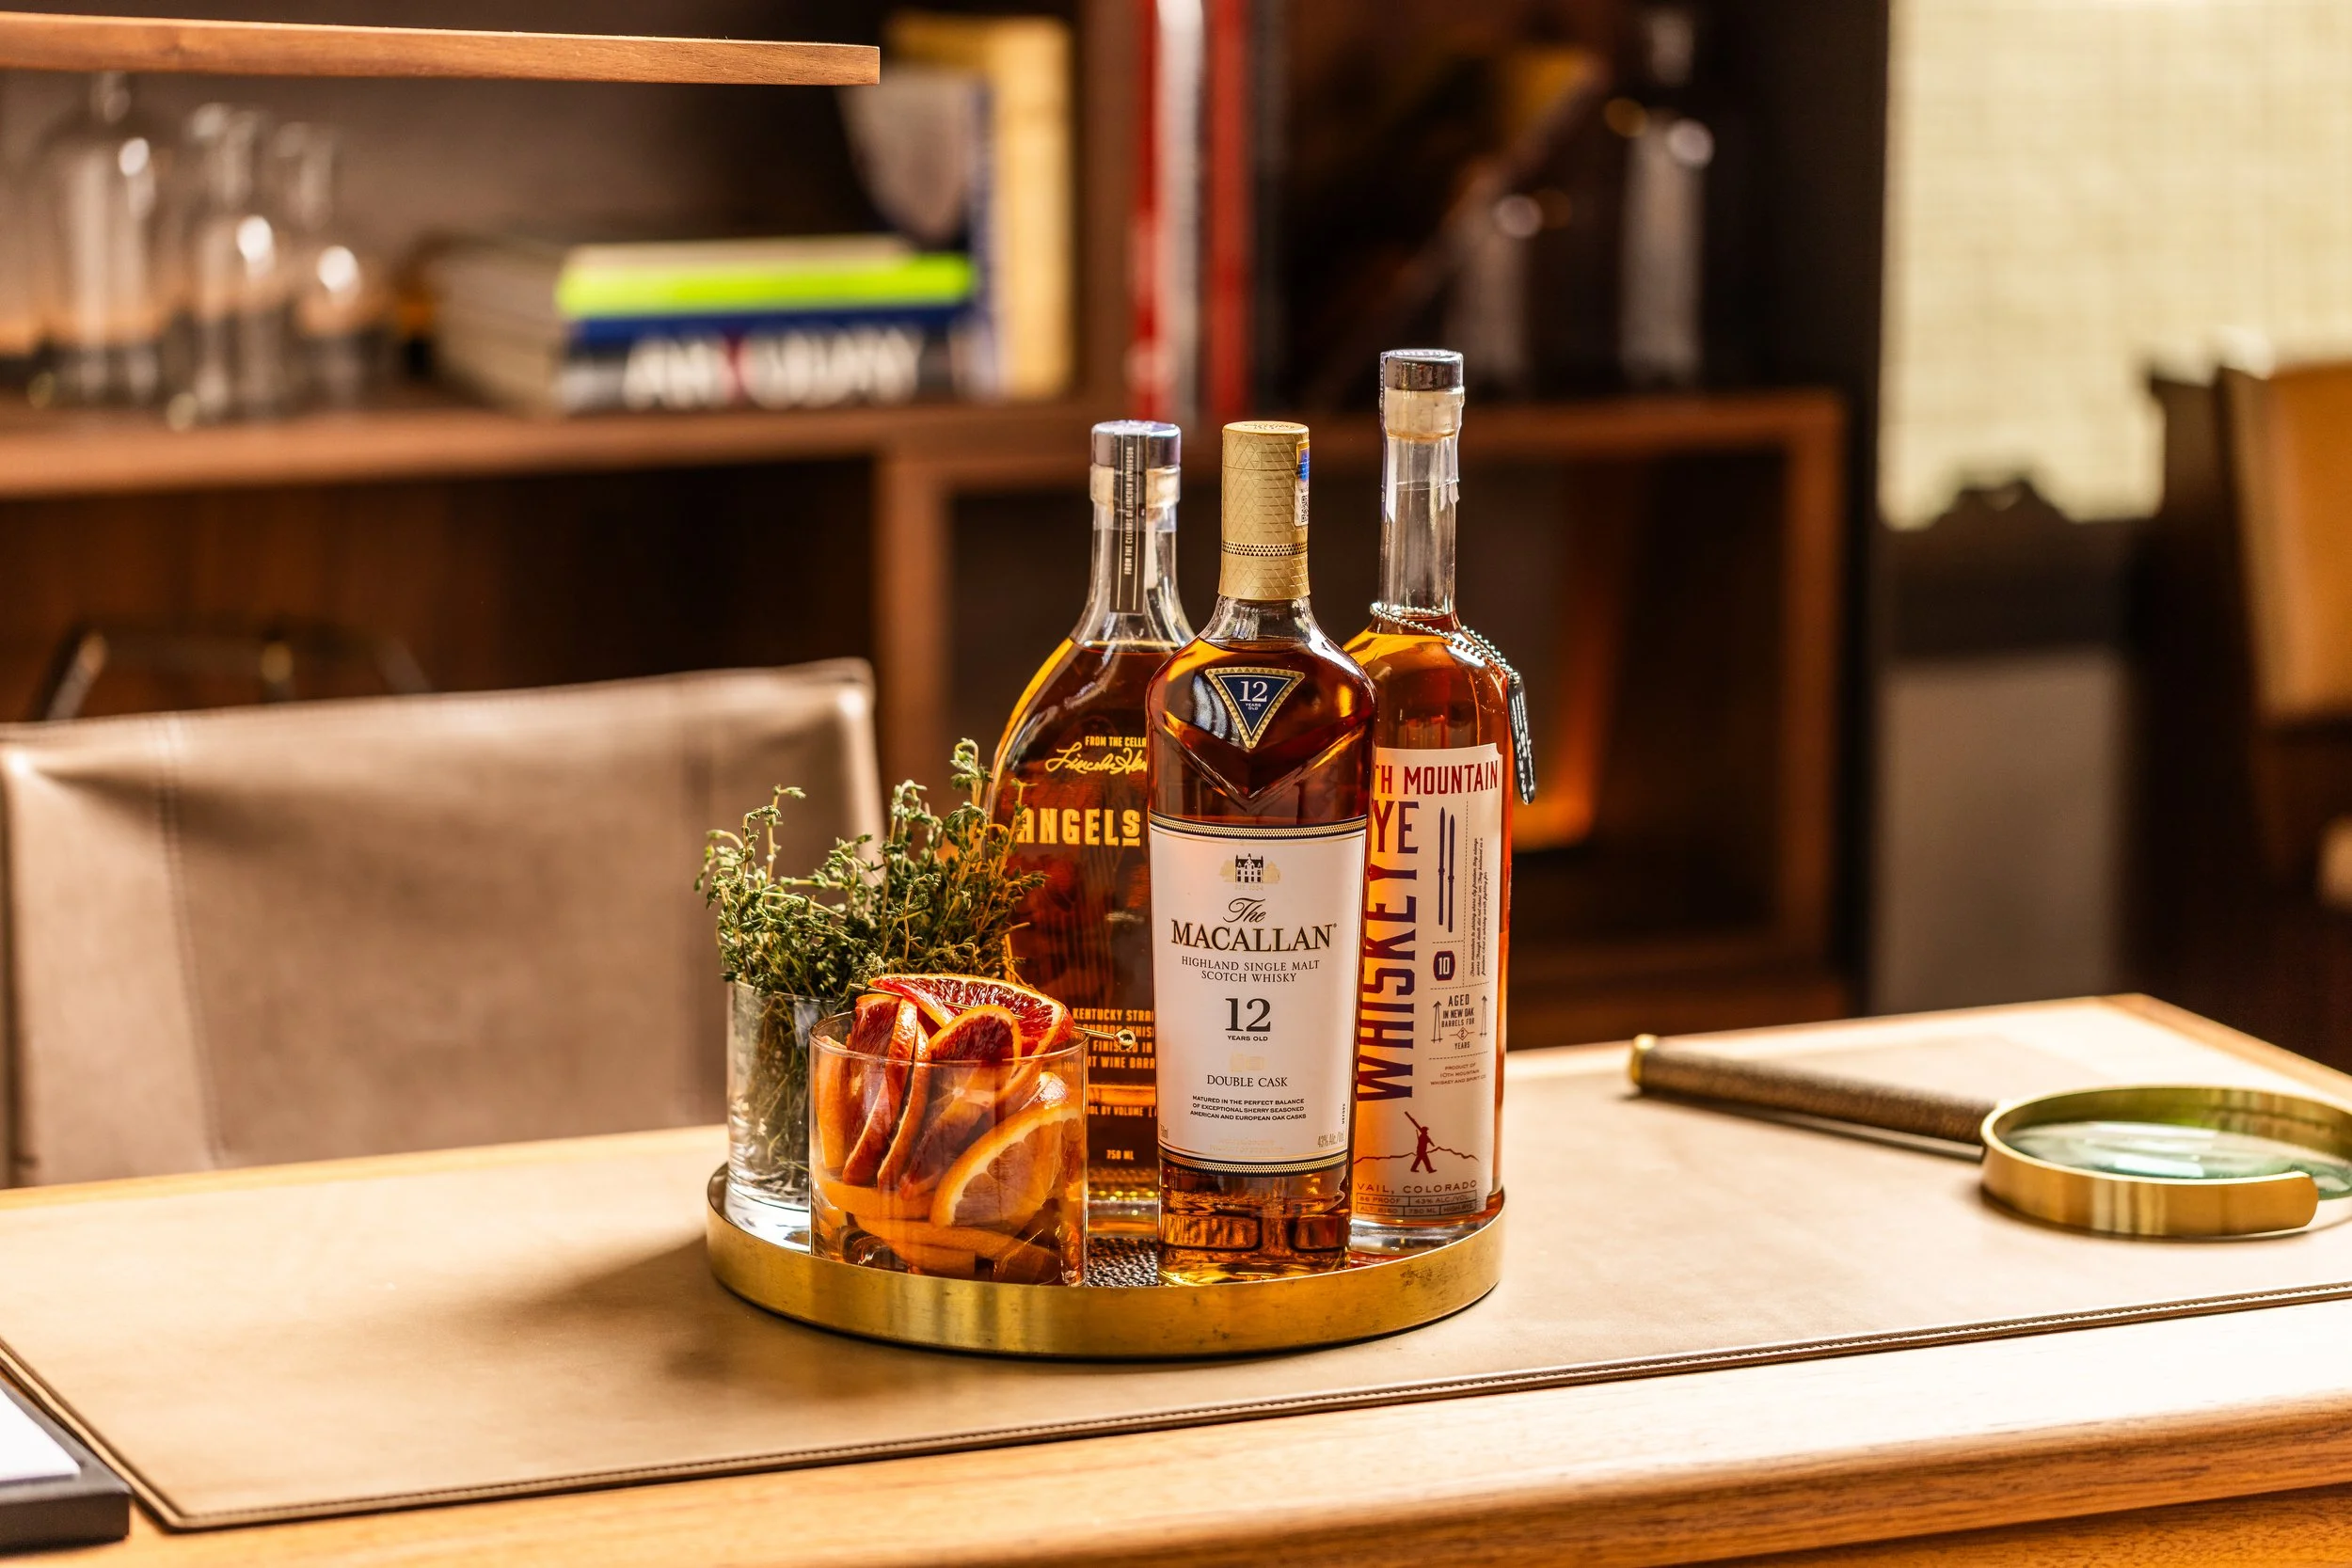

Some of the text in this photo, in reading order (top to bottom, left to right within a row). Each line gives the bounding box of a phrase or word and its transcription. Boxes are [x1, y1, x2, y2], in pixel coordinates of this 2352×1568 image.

[1239, 680, 1268, 702] 12
[1085, 736, 1106, 747] FROM
[1108, 736, 1123, 747] THE
[1045, 741, 1116, 774] Lincoln
[1403, 760, 1499, 796] MOUNTAIN
[1372, 800, 1420, 854] YE
[1222, 897, 1267, 924] The
[1170, 918, 1333, 952] MACALLAN
[1182, 955, 1320, 972] HIGHLAND SINGLE MALT
[1438, 957, 1450, 975] 10
[1201, 970, 1296, 983] SCOTCH WHISKY
[1357, 863, 1418, 1101] WHISKEY
[1448, 993, 1470, 1007] AGED
[1073, 1007, 1122, 1021] KENTUCKY
[1225, 998, 1271, 1033] 12
[1443, 1006, 1474, 1019] IN NEW OAK
[1441, 1019, 1464, 1028] BARRELS
[1460, 1029, 1464, 1037] 2
[1093, 1040, 1152, 1053] FINISD IN
[1454, 1041, 1470, 1050] YEARS
[1101, 1055, 1126, 1069] WINE
[1206, 1074, 1288, 1087] DOUBLE CASK
[1192, 1095, 1220, 1103] MATURED
[1101, 1106, 1111, 1116] BY
[1113, 1106, 1144, 1117] VOLUME
[1190, 1110, 1219, 1119] AMERICAN
[1201, 1104, 1243, 1113] EXCEPTIONAL
[1106, 1149, 1121, 1160] 750
[1357, 1180, 1477, 1195] VAIL, COLORADO
